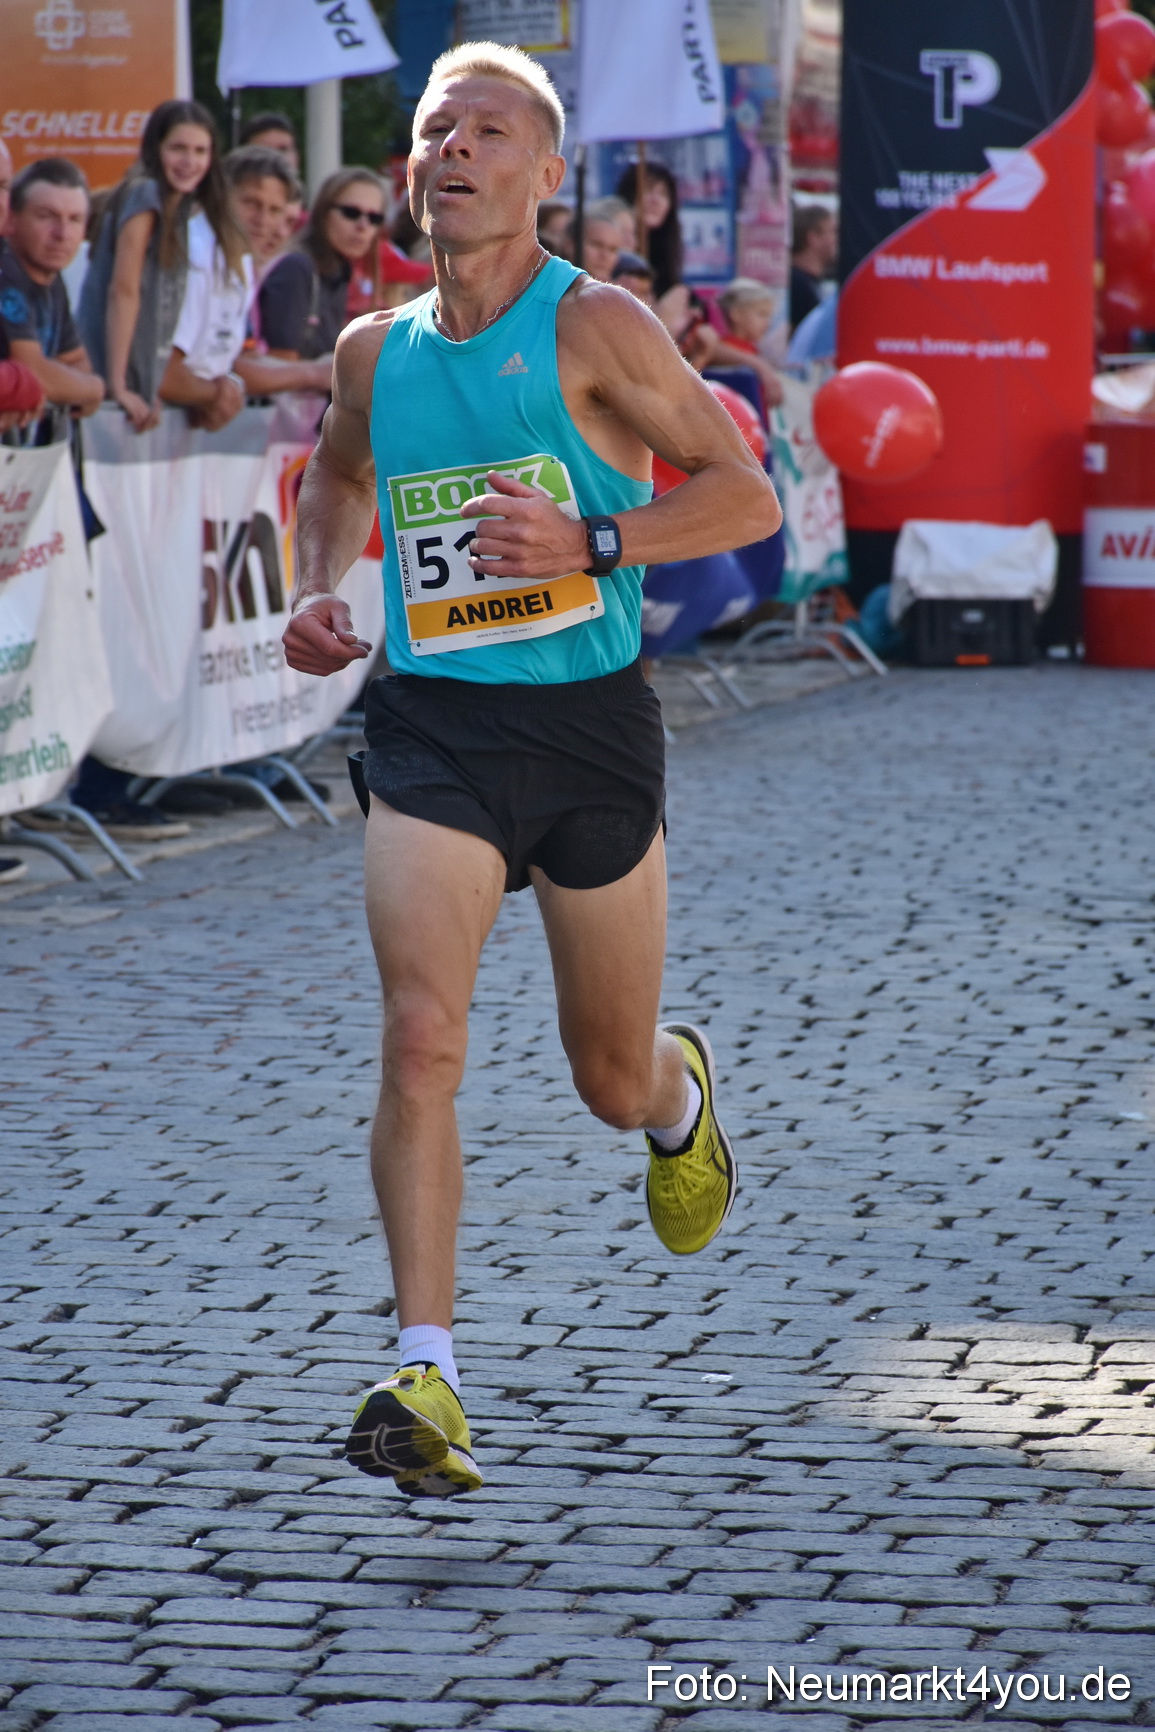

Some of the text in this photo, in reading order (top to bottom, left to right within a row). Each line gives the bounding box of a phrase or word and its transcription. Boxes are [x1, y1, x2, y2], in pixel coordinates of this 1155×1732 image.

[316, 0, 364, 49] PA
[898, 171, 929, 188] THE
[874, 255, 1049, 286] BMW Laufsport
[498, 366, 528, 376] adidas
[415, 531, 508, 590] 51
[447, 590, 553, 627] ANDREI
